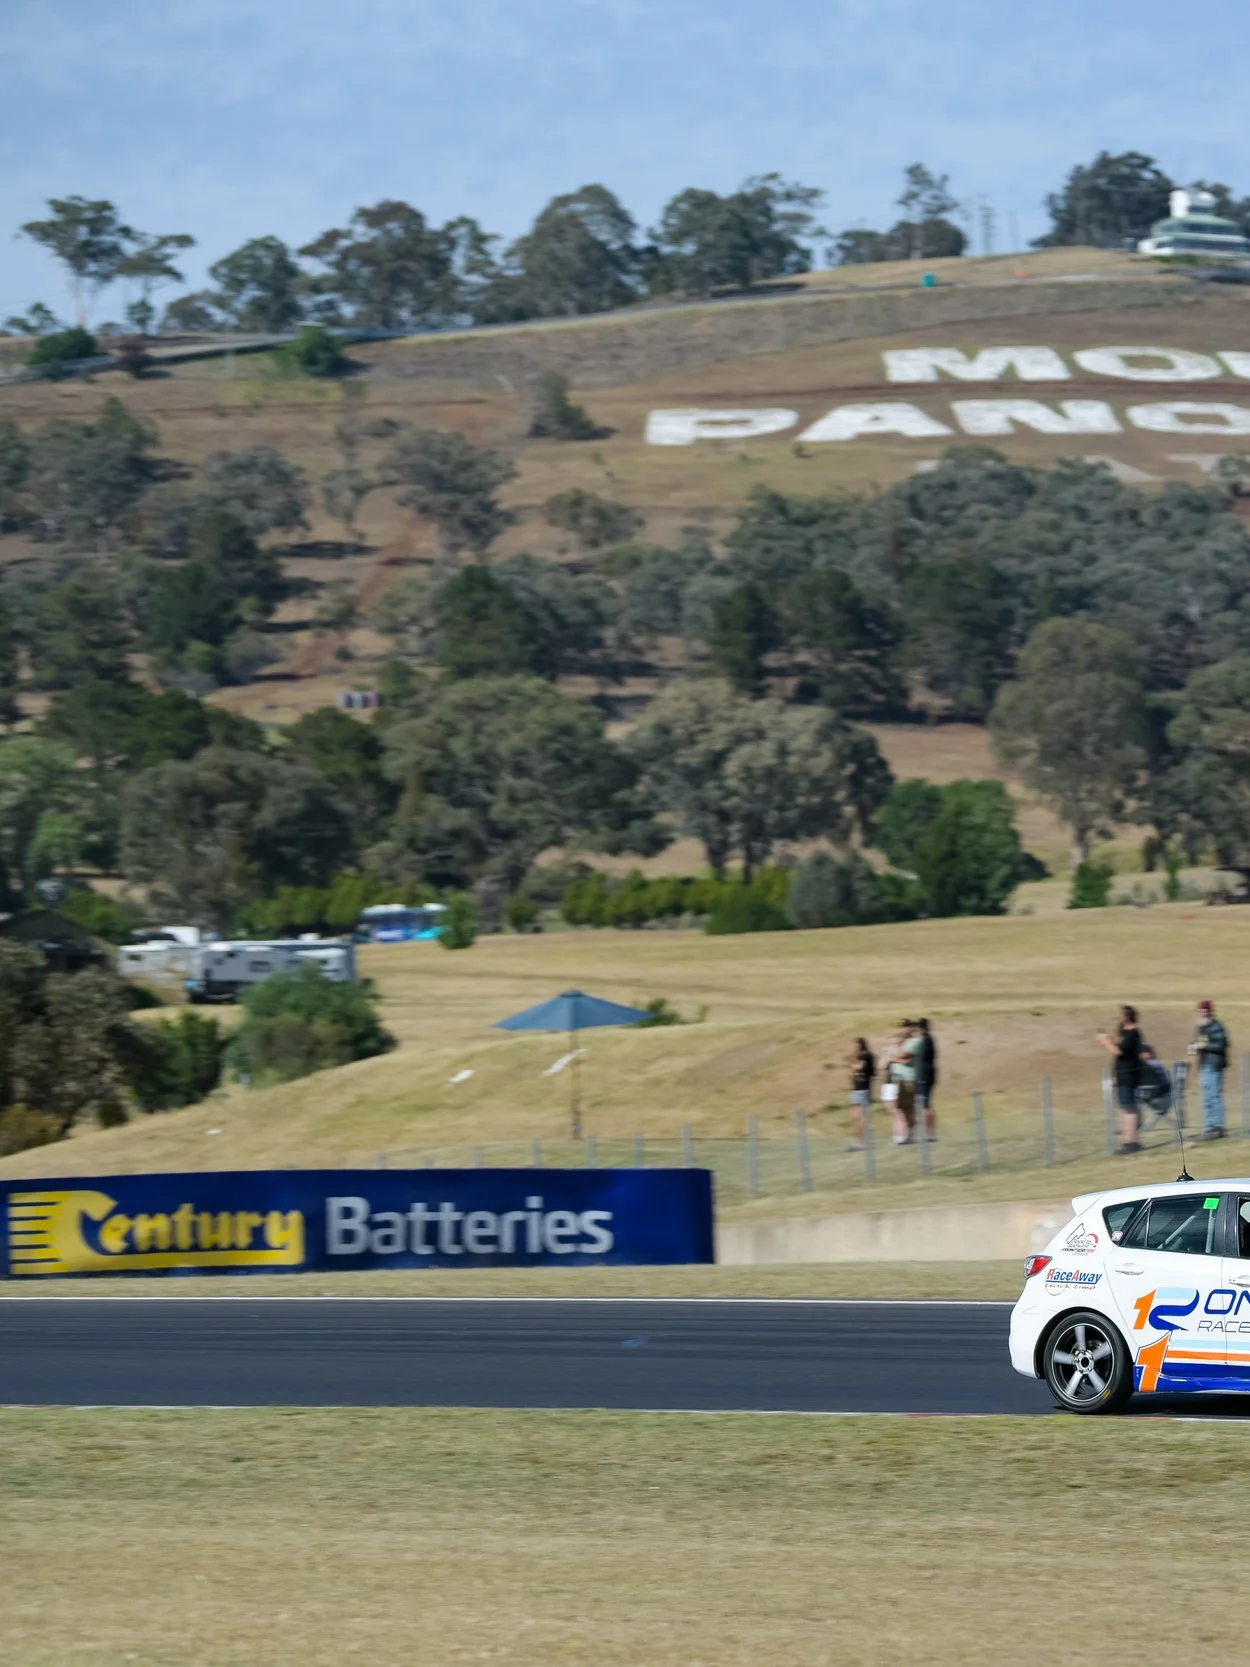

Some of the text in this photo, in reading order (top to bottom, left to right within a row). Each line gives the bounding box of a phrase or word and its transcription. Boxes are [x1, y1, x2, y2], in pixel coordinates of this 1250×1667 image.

[7, 1190, 615, 1274] Century Batteries
[1047, 1268, 1102, 1282] RaceAway
